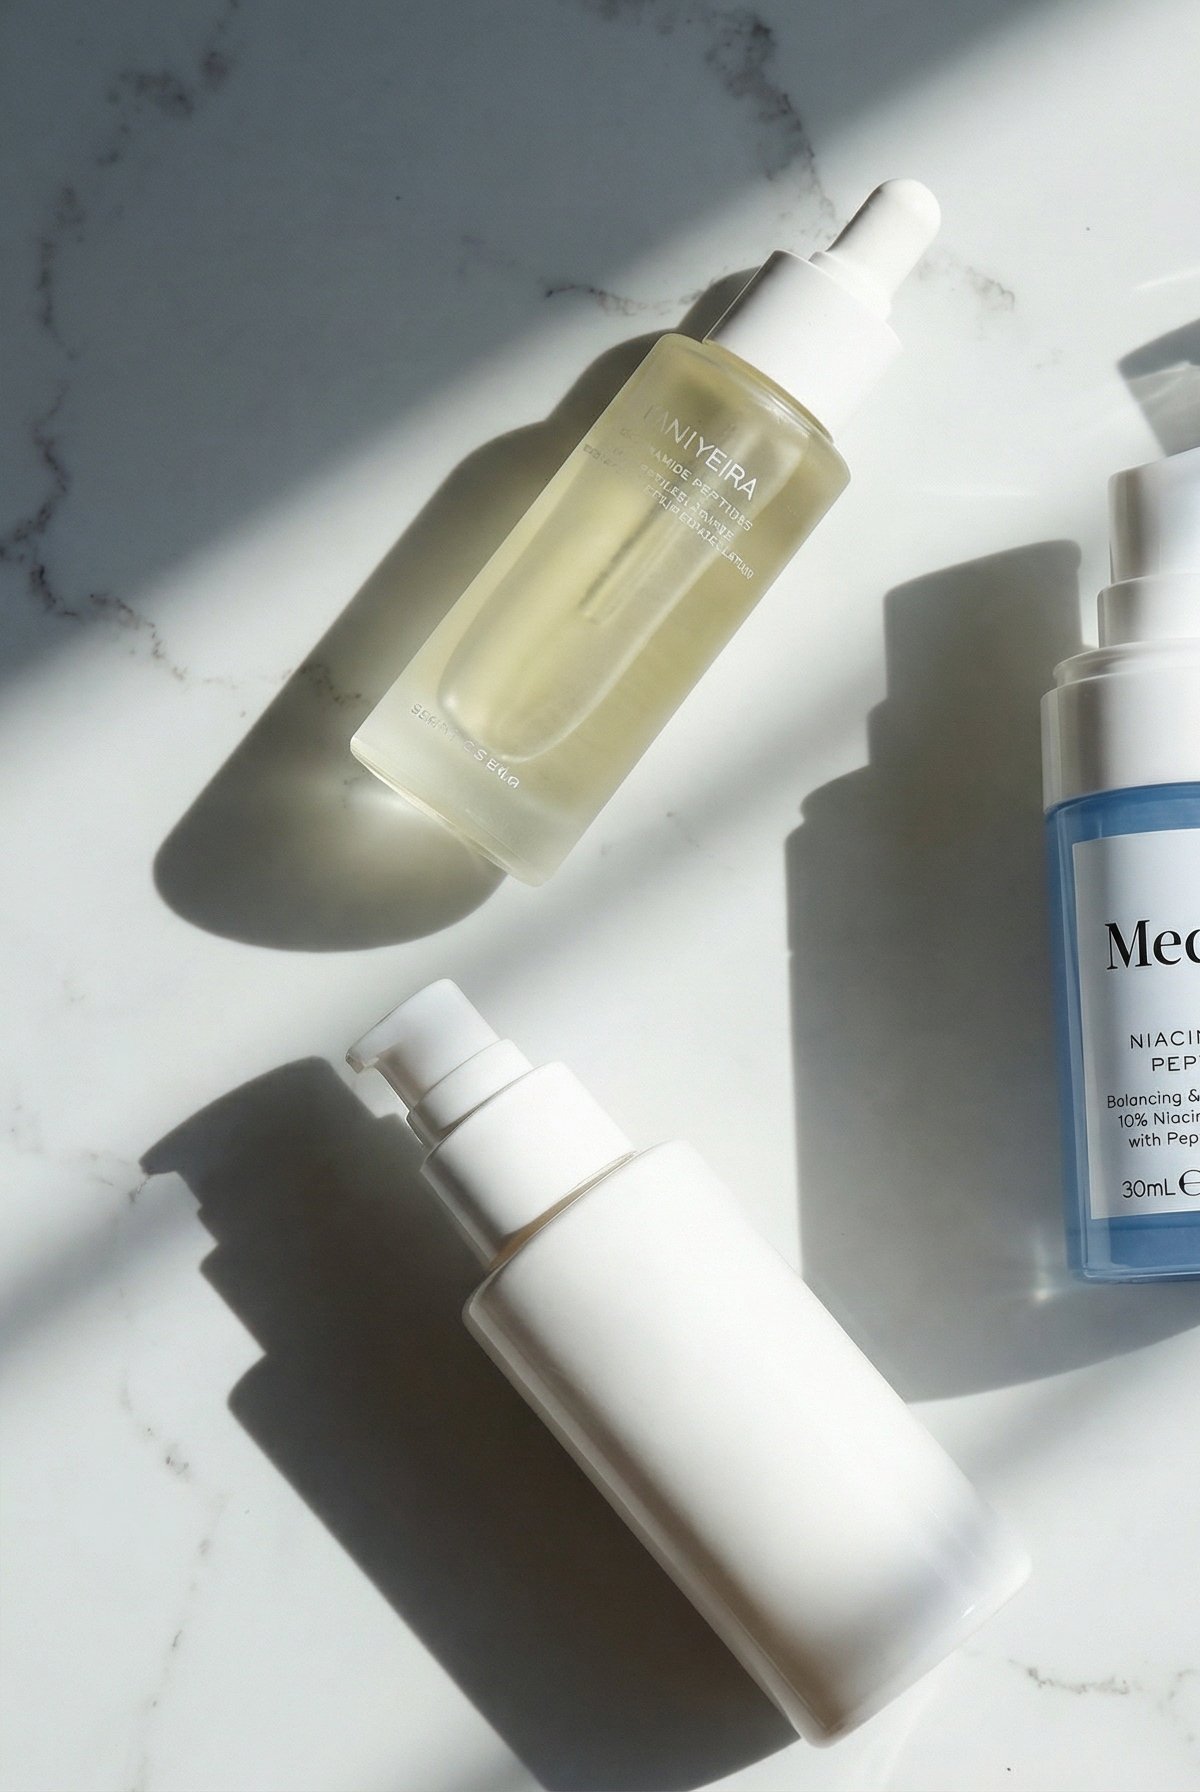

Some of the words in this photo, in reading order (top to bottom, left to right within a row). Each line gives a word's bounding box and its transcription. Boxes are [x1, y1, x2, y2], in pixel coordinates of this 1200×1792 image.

[1188, 1088, 1200, 1103] &
[1118, 1112, 1148, 1129] 10%
[1128, 1132, 1161, 1149] with
